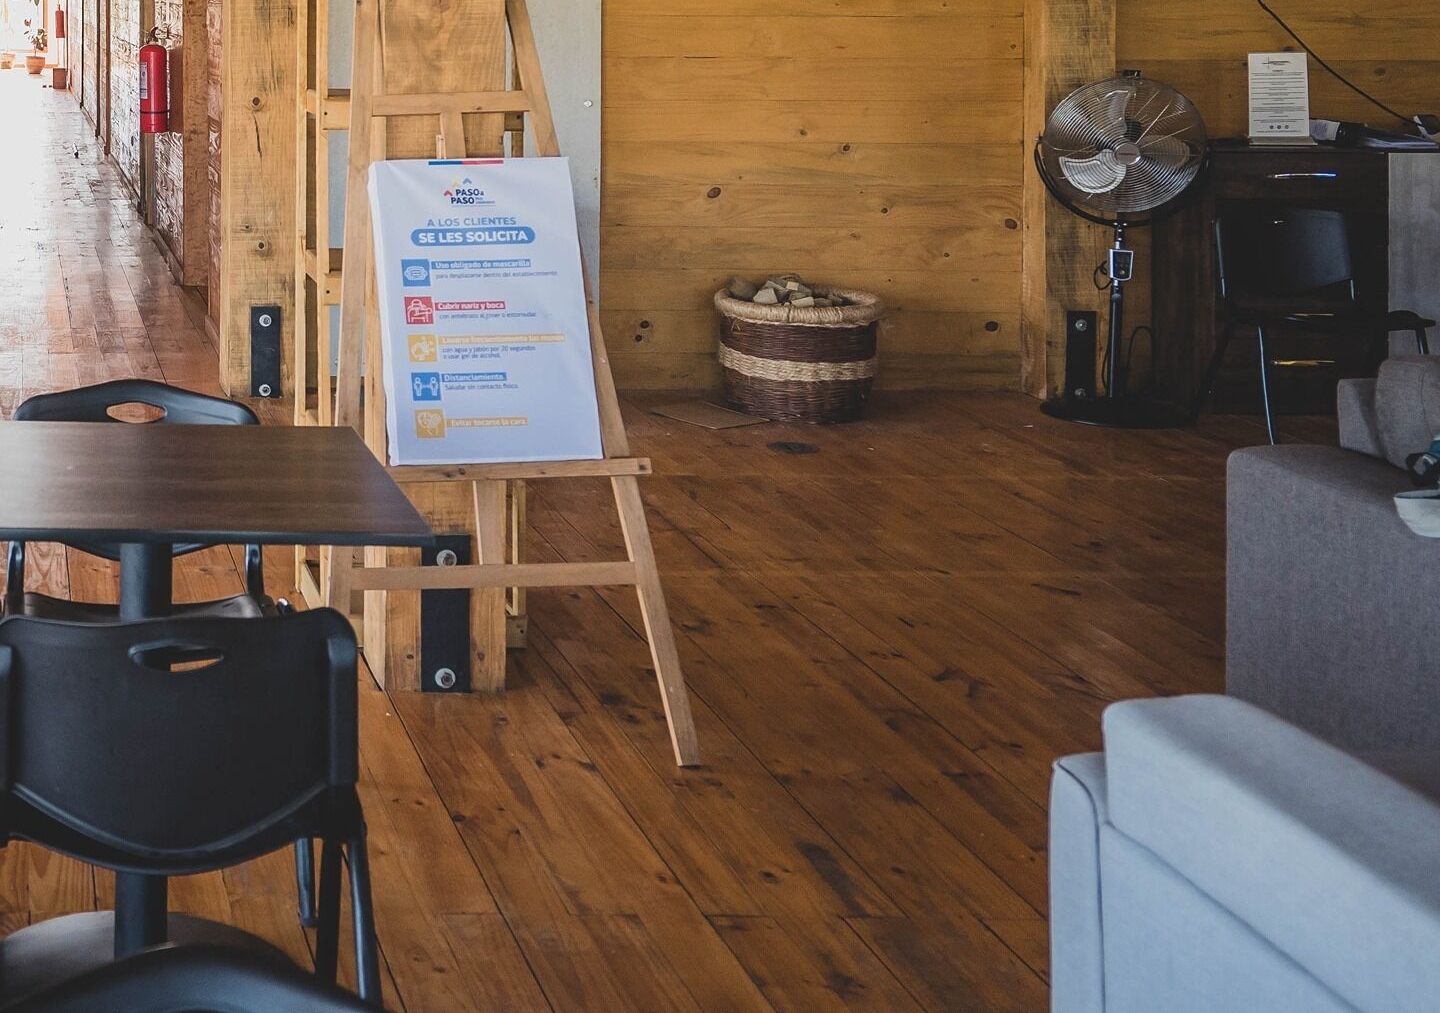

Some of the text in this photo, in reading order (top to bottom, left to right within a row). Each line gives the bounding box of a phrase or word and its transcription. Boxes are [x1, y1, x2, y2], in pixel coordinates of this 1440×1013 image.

[455, 188, 480, 197] PASO
[450, 196, 475, 205] PASO
[426, 216, 517, 227] A LOS CLIENTES
[418, 229, 529, 244] SE LES SOLICITA
[492, 259, 530, 267] mascarilla
[486, 301, 505, 309] boca
